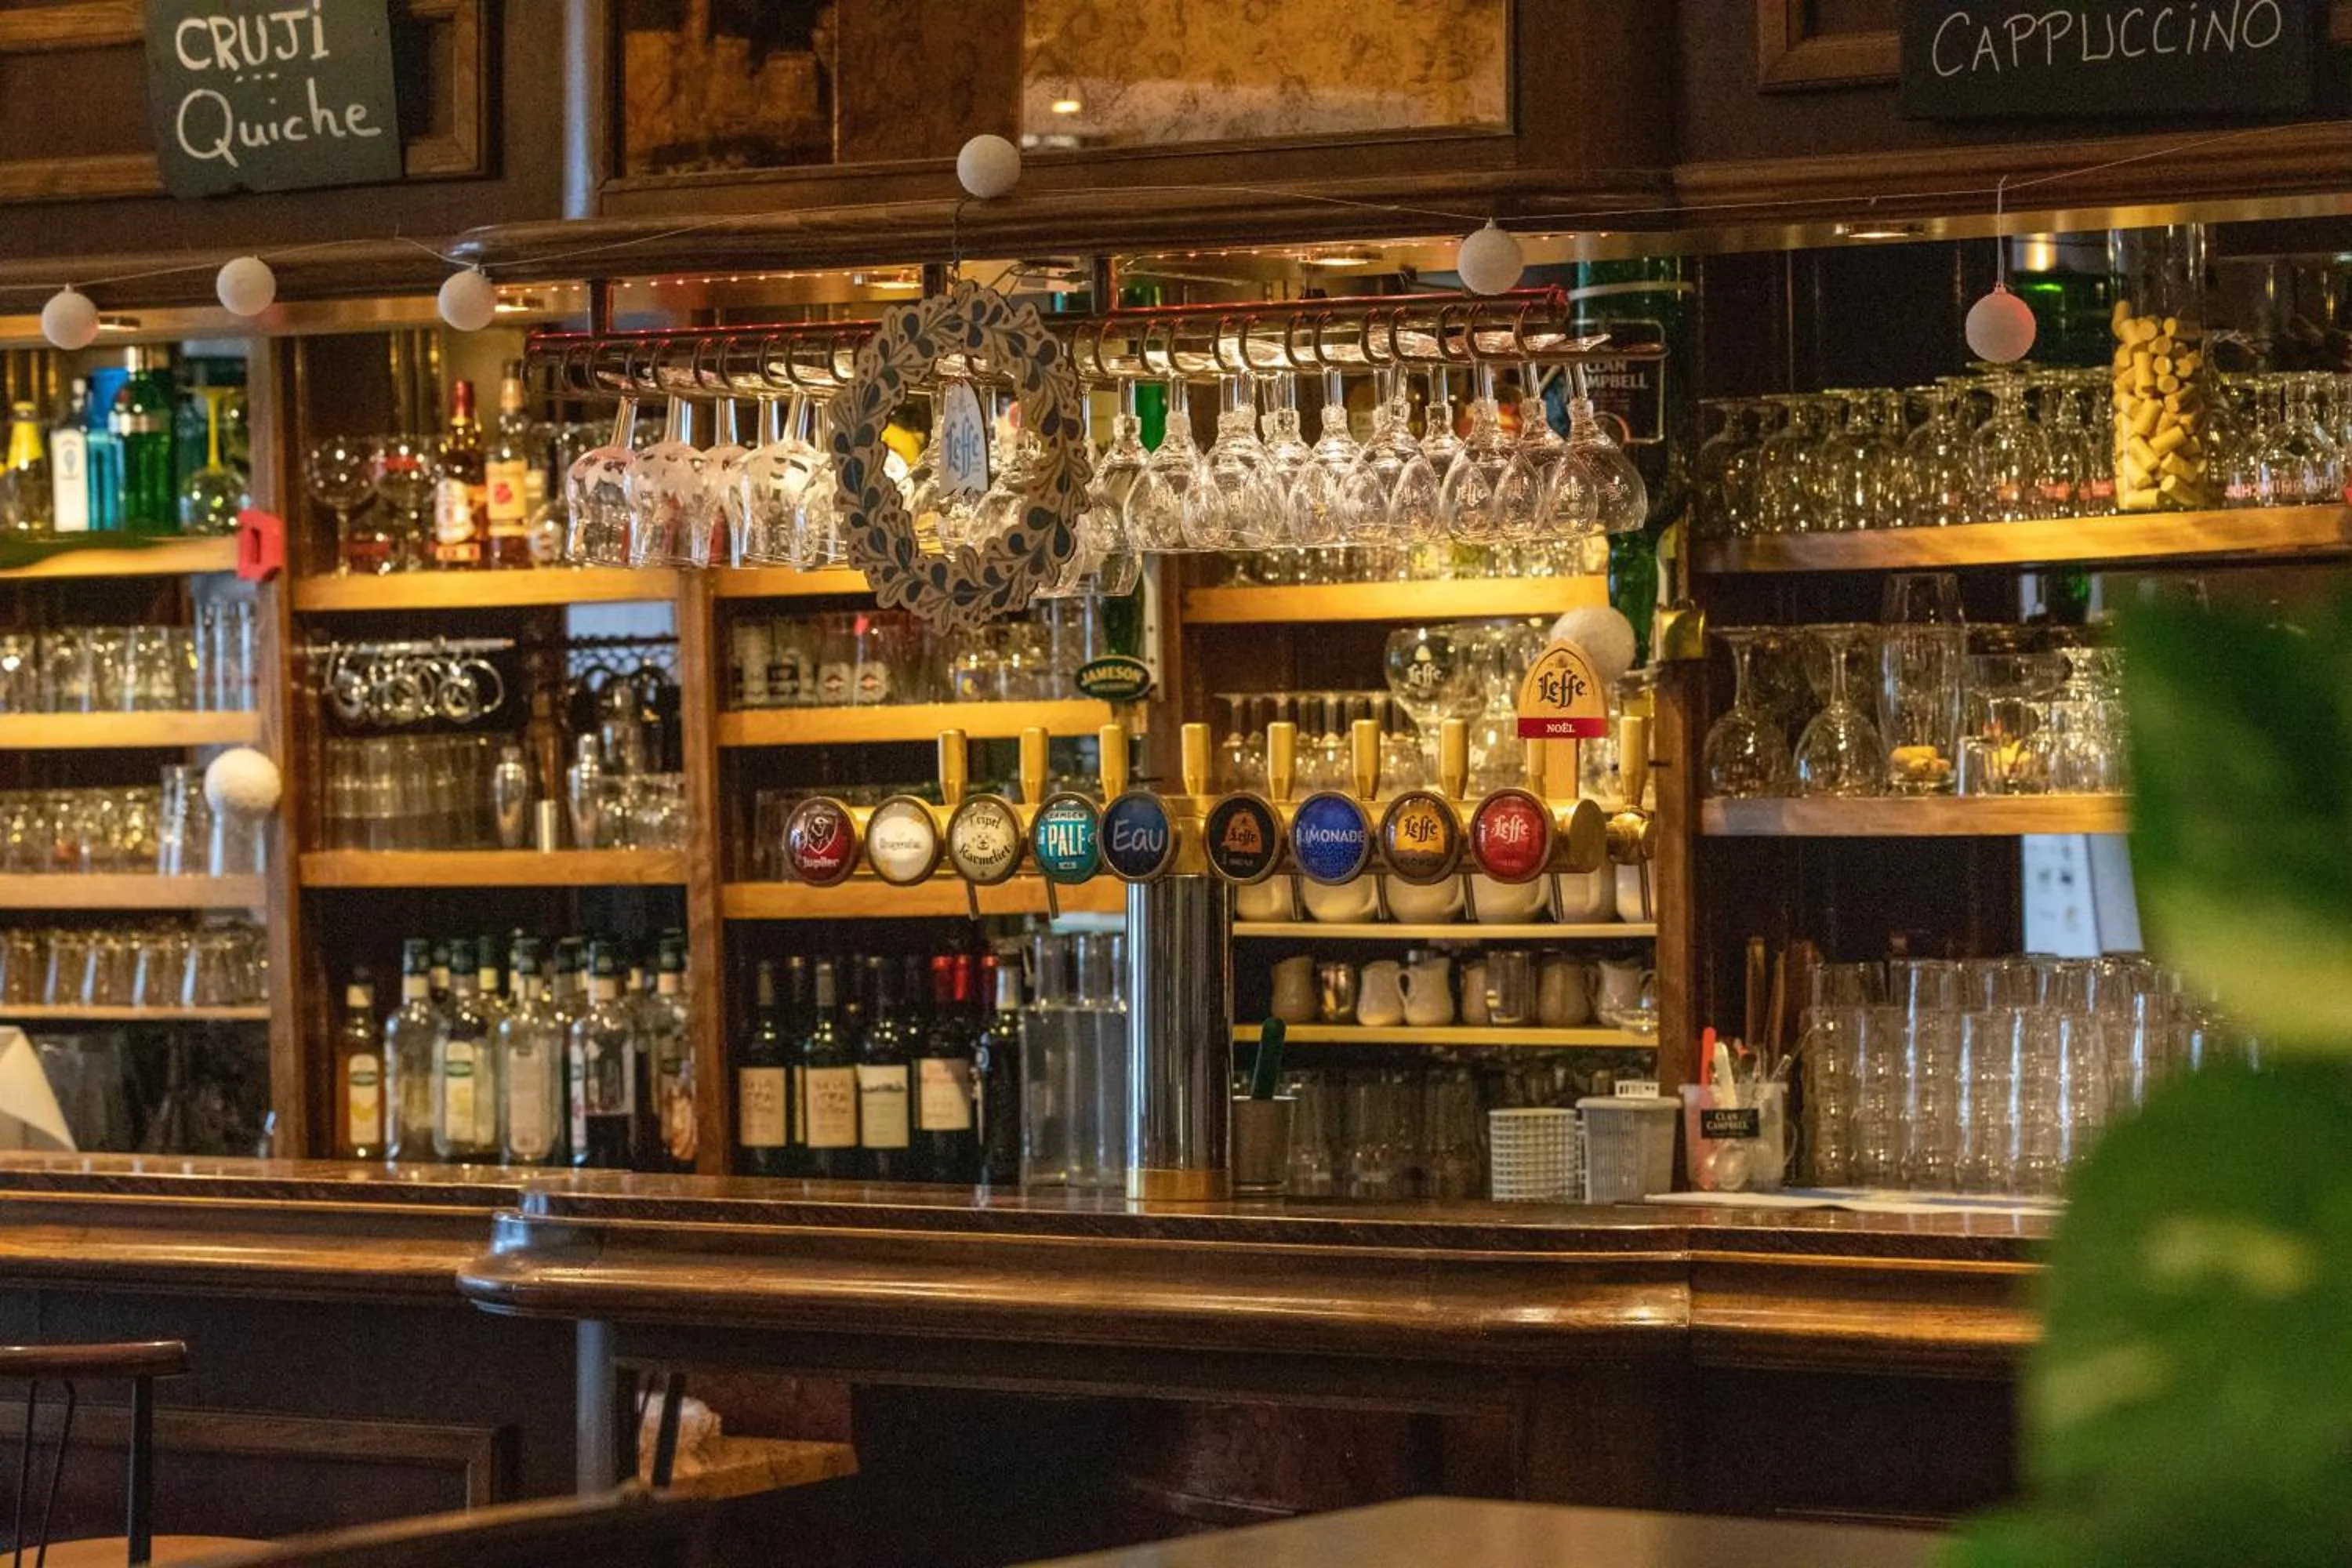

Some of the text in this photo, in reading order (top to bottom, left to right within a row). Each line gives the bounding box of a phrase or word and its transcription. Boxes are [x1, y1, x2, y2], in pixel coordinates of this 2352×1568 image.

[176, 78, 381, 168] Quiche
[946, 416, 980, 481] Leffe
[1406, 662, 1443, 690] Leffe
[1537, 669, 1587, 710] Leffe
[1546, 721, 1576, 733] NOËL
[1047, 823, 1087, 857] PALE
[1112, 818, 1164, 852] Eau
[1296, 825, 1366, 844] LIMONADE
[1404, 815, 1439, 843] Leffe
[1492, 814, 1530, 845] Leffe
